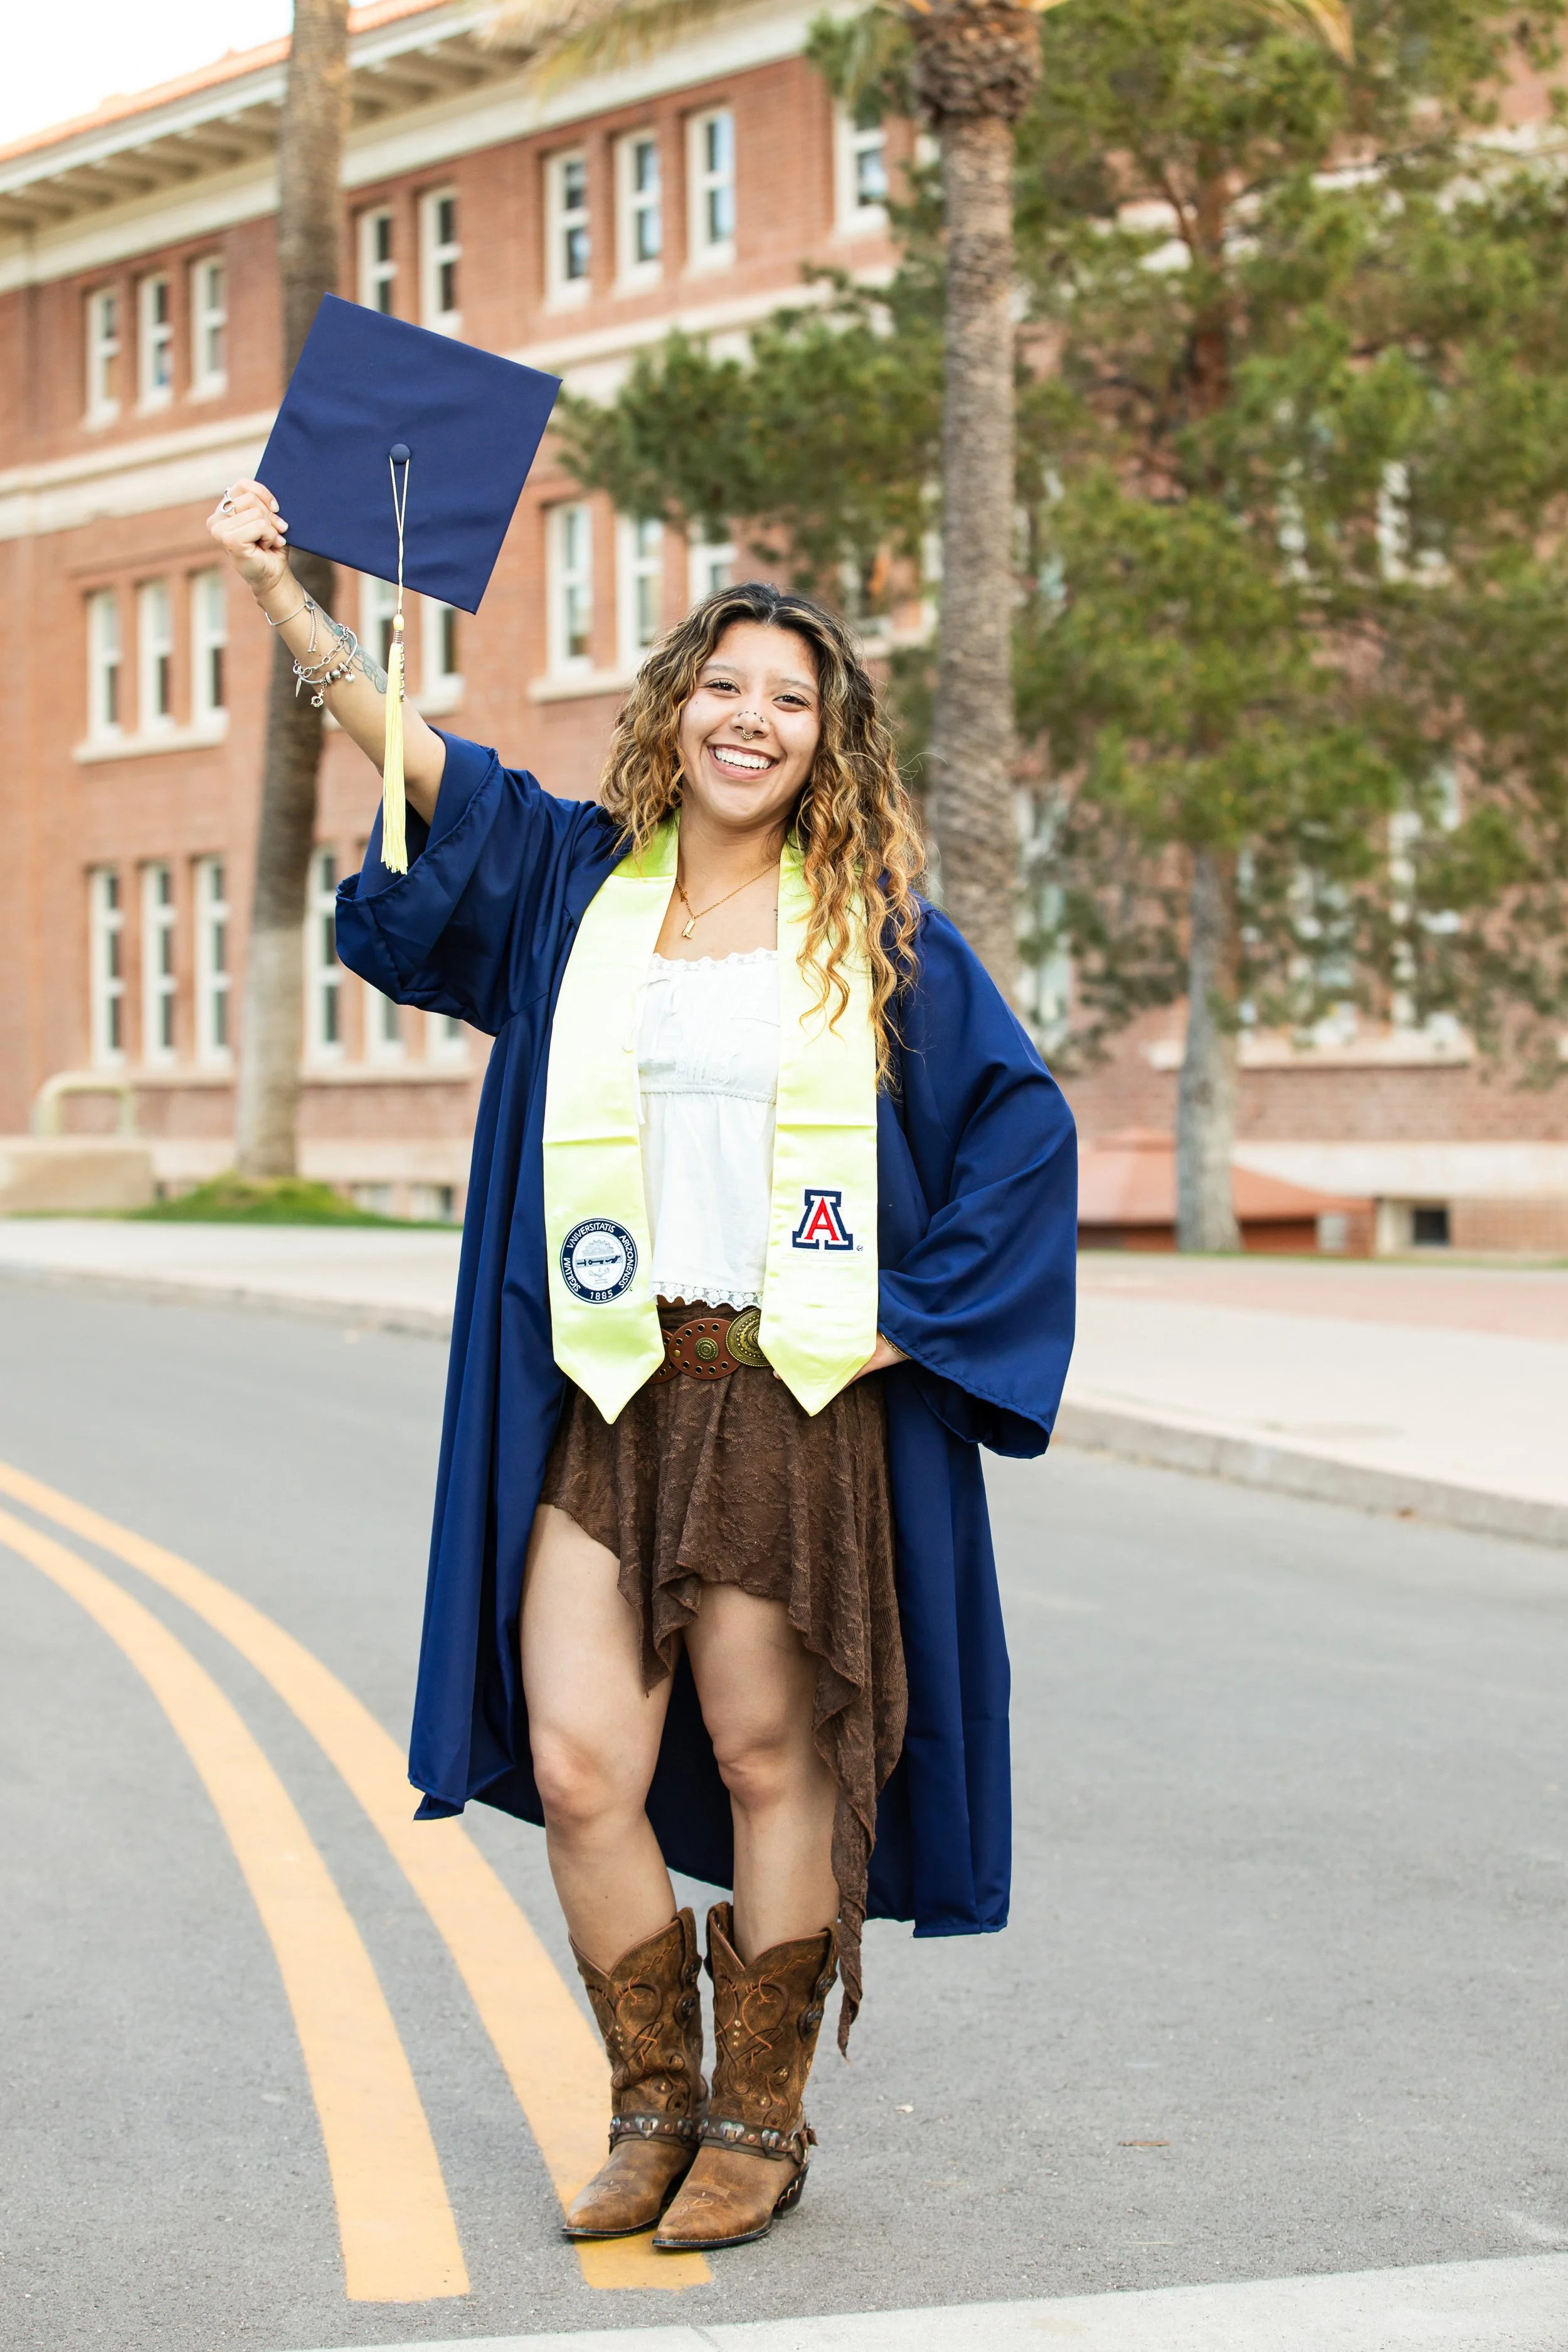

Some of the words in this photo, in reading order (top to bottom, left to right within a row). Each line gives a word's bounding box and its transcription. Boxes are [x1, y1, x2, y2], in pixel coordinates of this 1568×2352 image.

[792, 1189, 853, 1250] A
[618, 1235, 634, 1289] ARIZONENSIS
[590, 1290, 613, 1300] 1885
